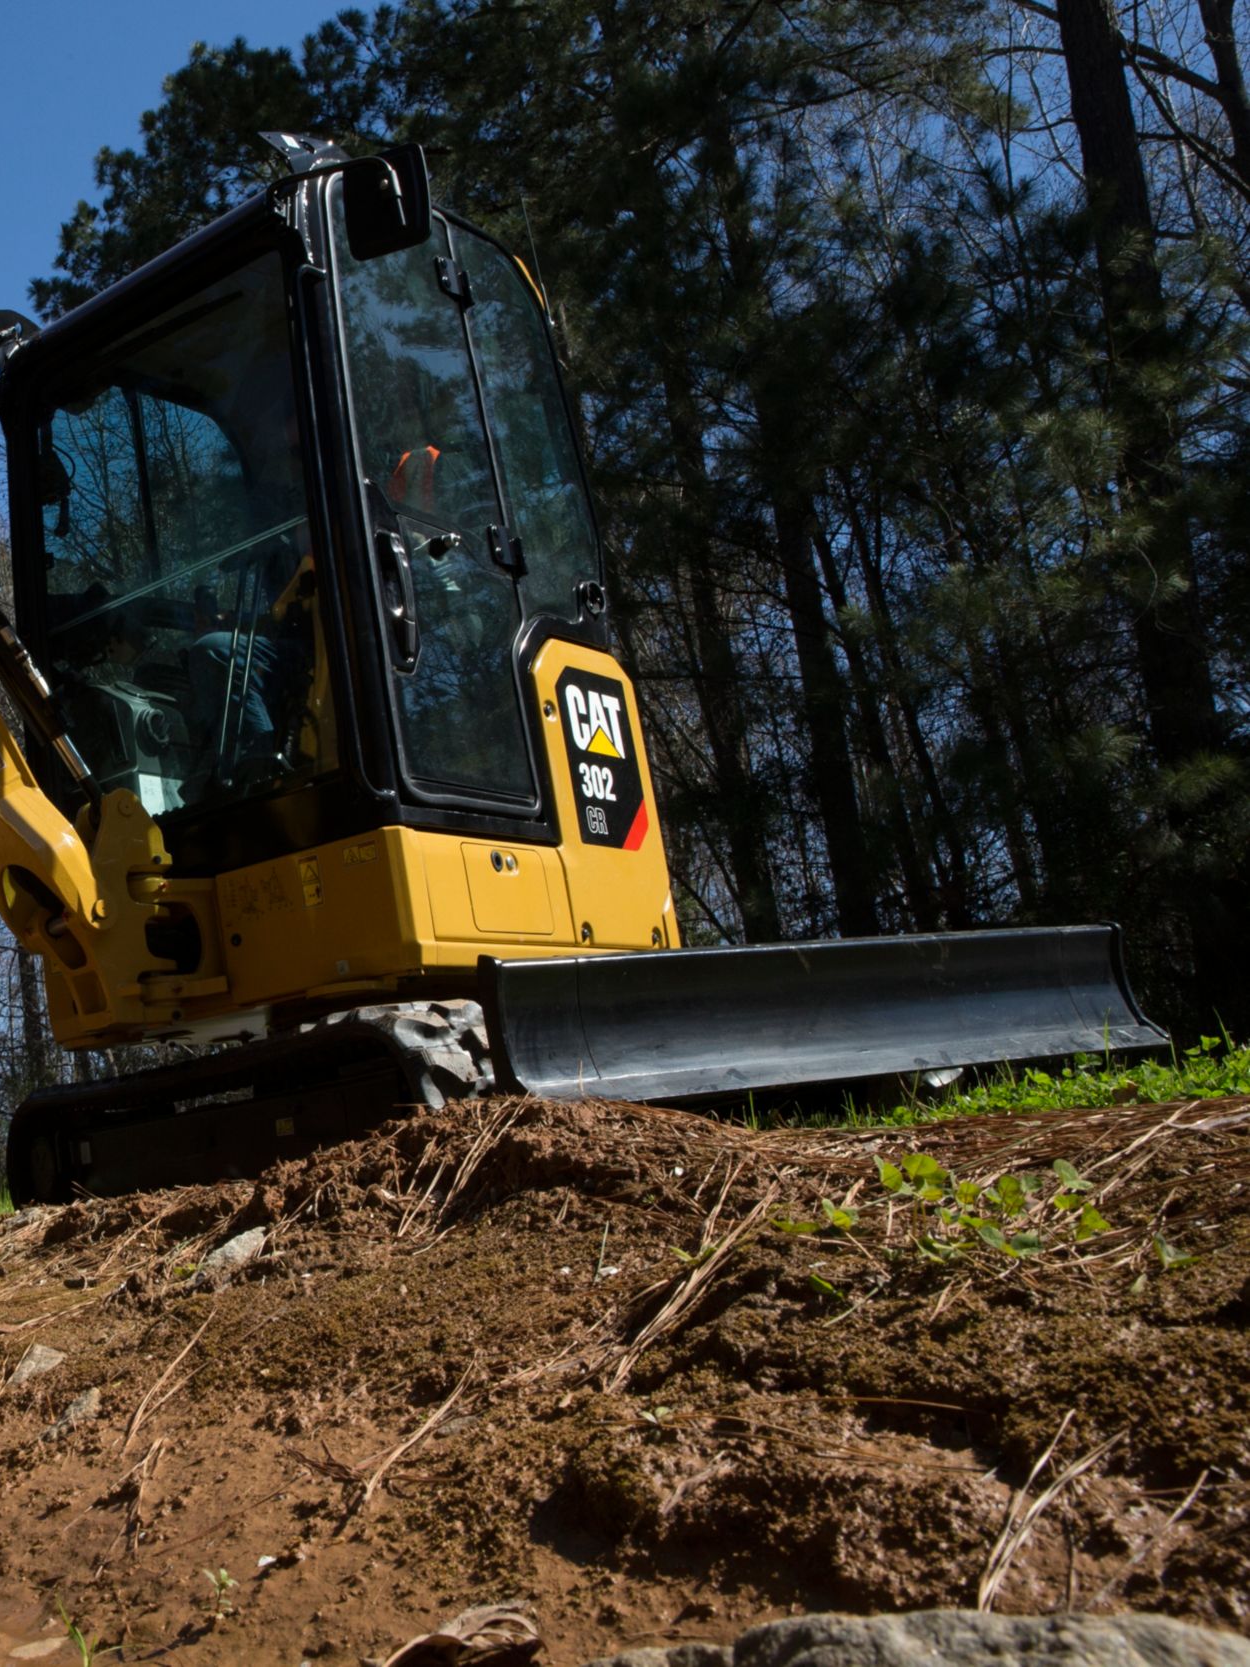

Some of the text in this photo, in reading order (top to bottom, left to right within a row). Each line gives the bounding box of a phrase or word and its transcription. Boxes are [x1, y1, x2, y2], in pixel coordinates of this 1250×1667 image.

[565, 684, 625, 759] CAT
[579, 762, 617, 801] 302
[586, 805, 609, 835] CR
